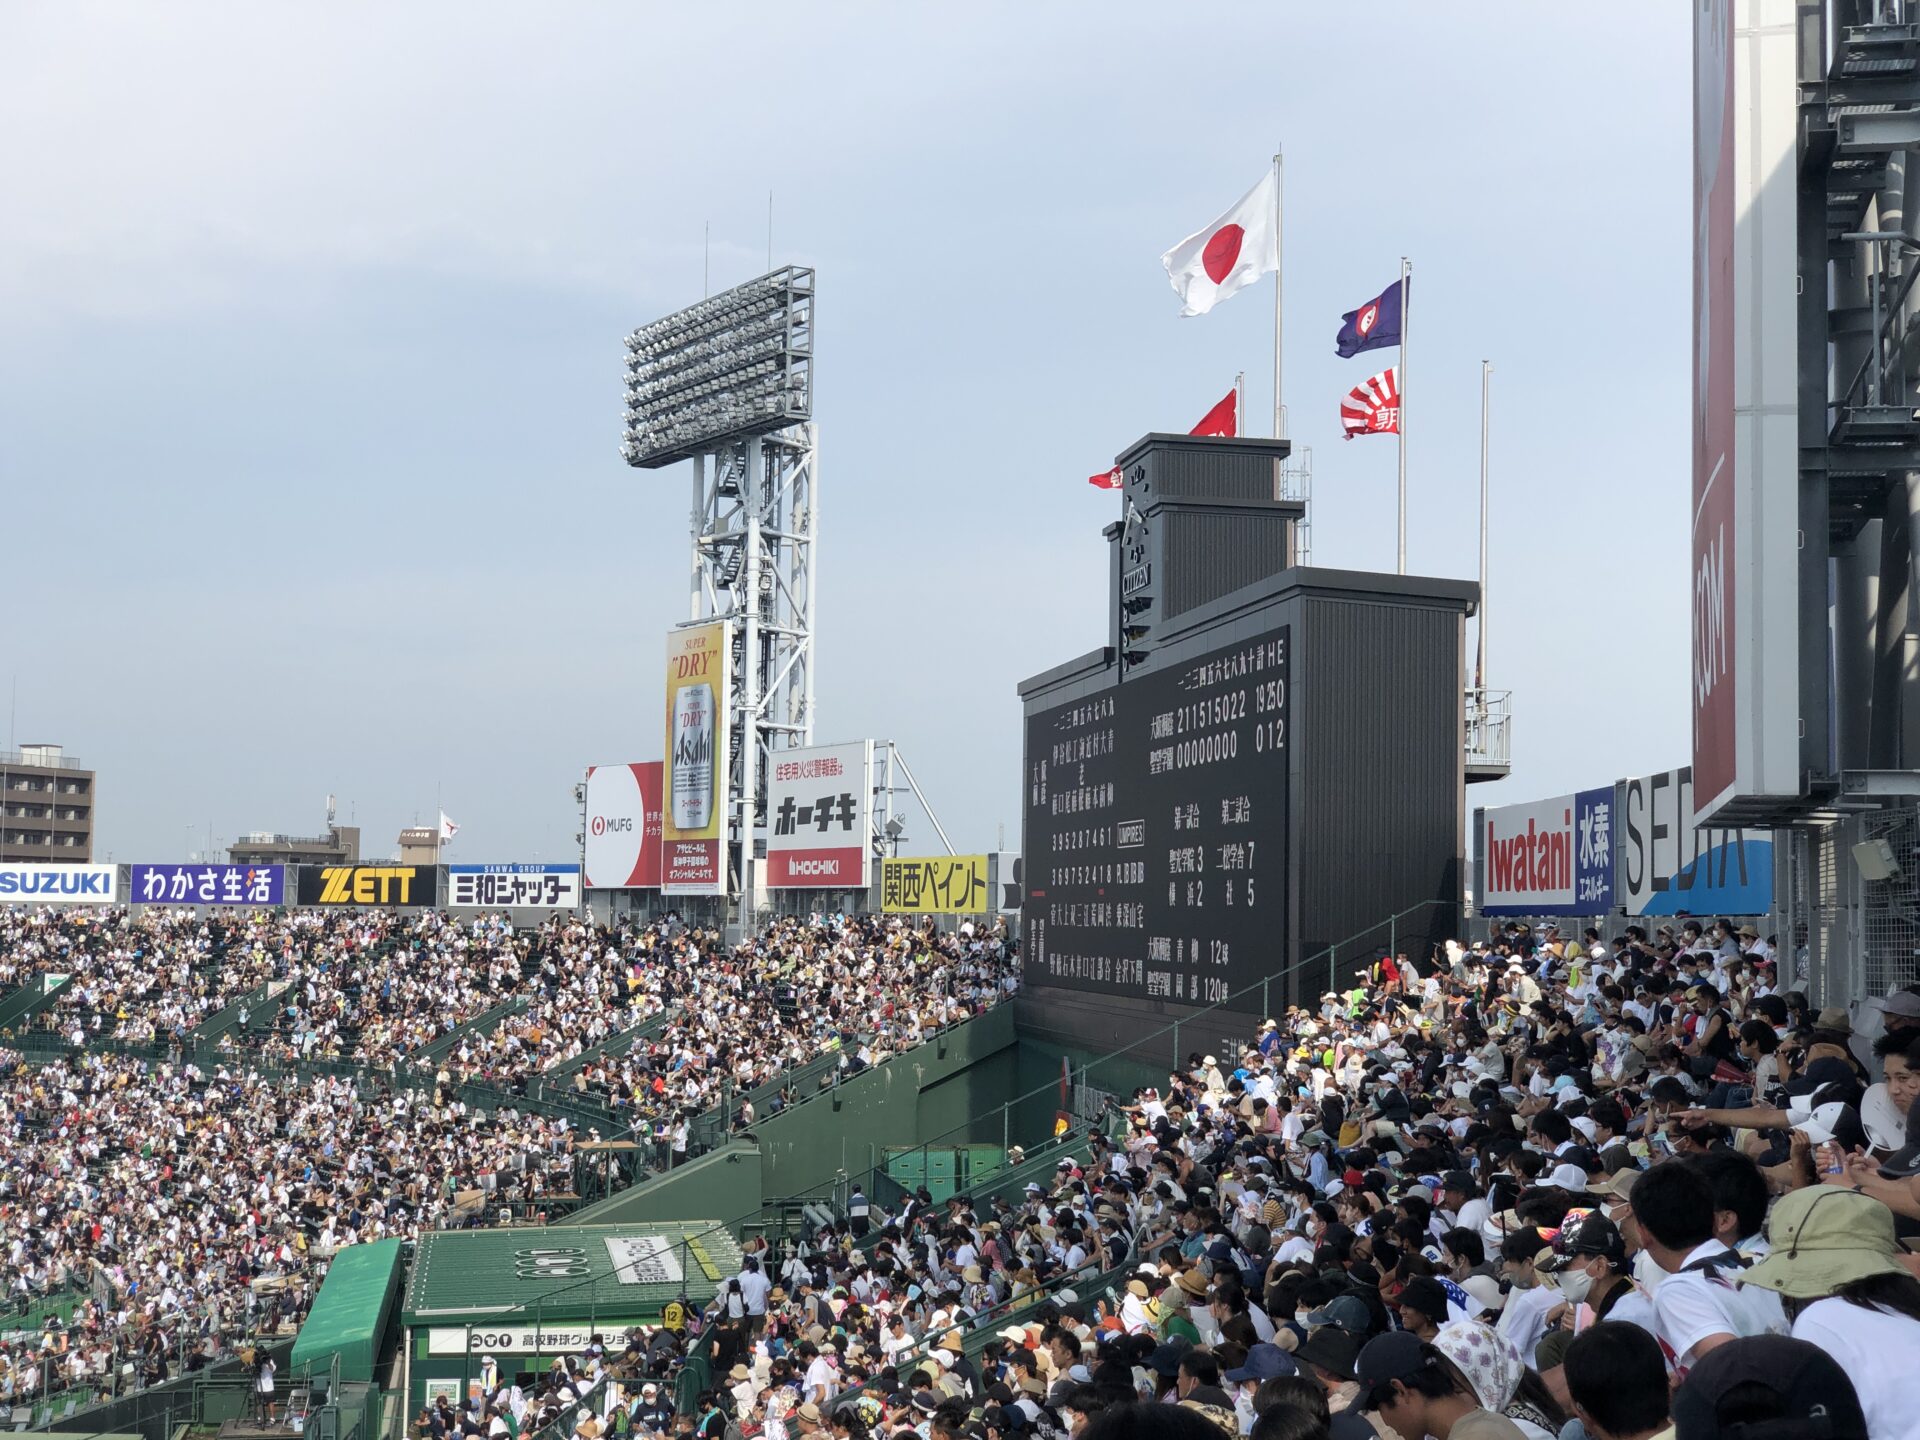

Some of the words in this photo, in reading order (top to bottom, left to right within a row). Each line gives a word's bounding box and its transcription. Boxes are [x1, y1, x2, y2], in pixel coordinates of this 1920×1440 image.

[1123, 565, 1148, 595] CITIZEN
[685, 637, 706, 650] SUPER
[675, 728, 711, 767] Asahi
[776, 758, 844, 781] 住宅用火災警報器は
[606, 817, 632, 832] MUFG
[774, 793, 857, 835] ホーチキ
[1174, 803, 1200, 830] 第一試合
[1222, 795, 1250, 825] 第二試合
[1119, 825, 1143, 844] UMPIRES
[1580, 802, 1610, 870] 水素
[1216, 843, 1244, 870] 二松学舎
[1248, 841, 1255, 869] 7
[1489, 808, 1571, 893] Iwatani
[484, 865, 513, 873] SANWA
[518, 865, 546, 873] GROUP
[796, 860, 839, 875] HOCHIKI
[0, 872, 111, 894] SUZUKI
[143, 867, 272, 901] わかさ生活
[319, 867, 416, 903] ZETT
[456, 874, 572, 905] 三和シャッター
[884, 860, 986, 908] 関西ペイント
[1247, 878, 1254, 907] 5
[1580, 873, 1610, 902] エネルギー
[667, 1311, 678, 1322] 12
